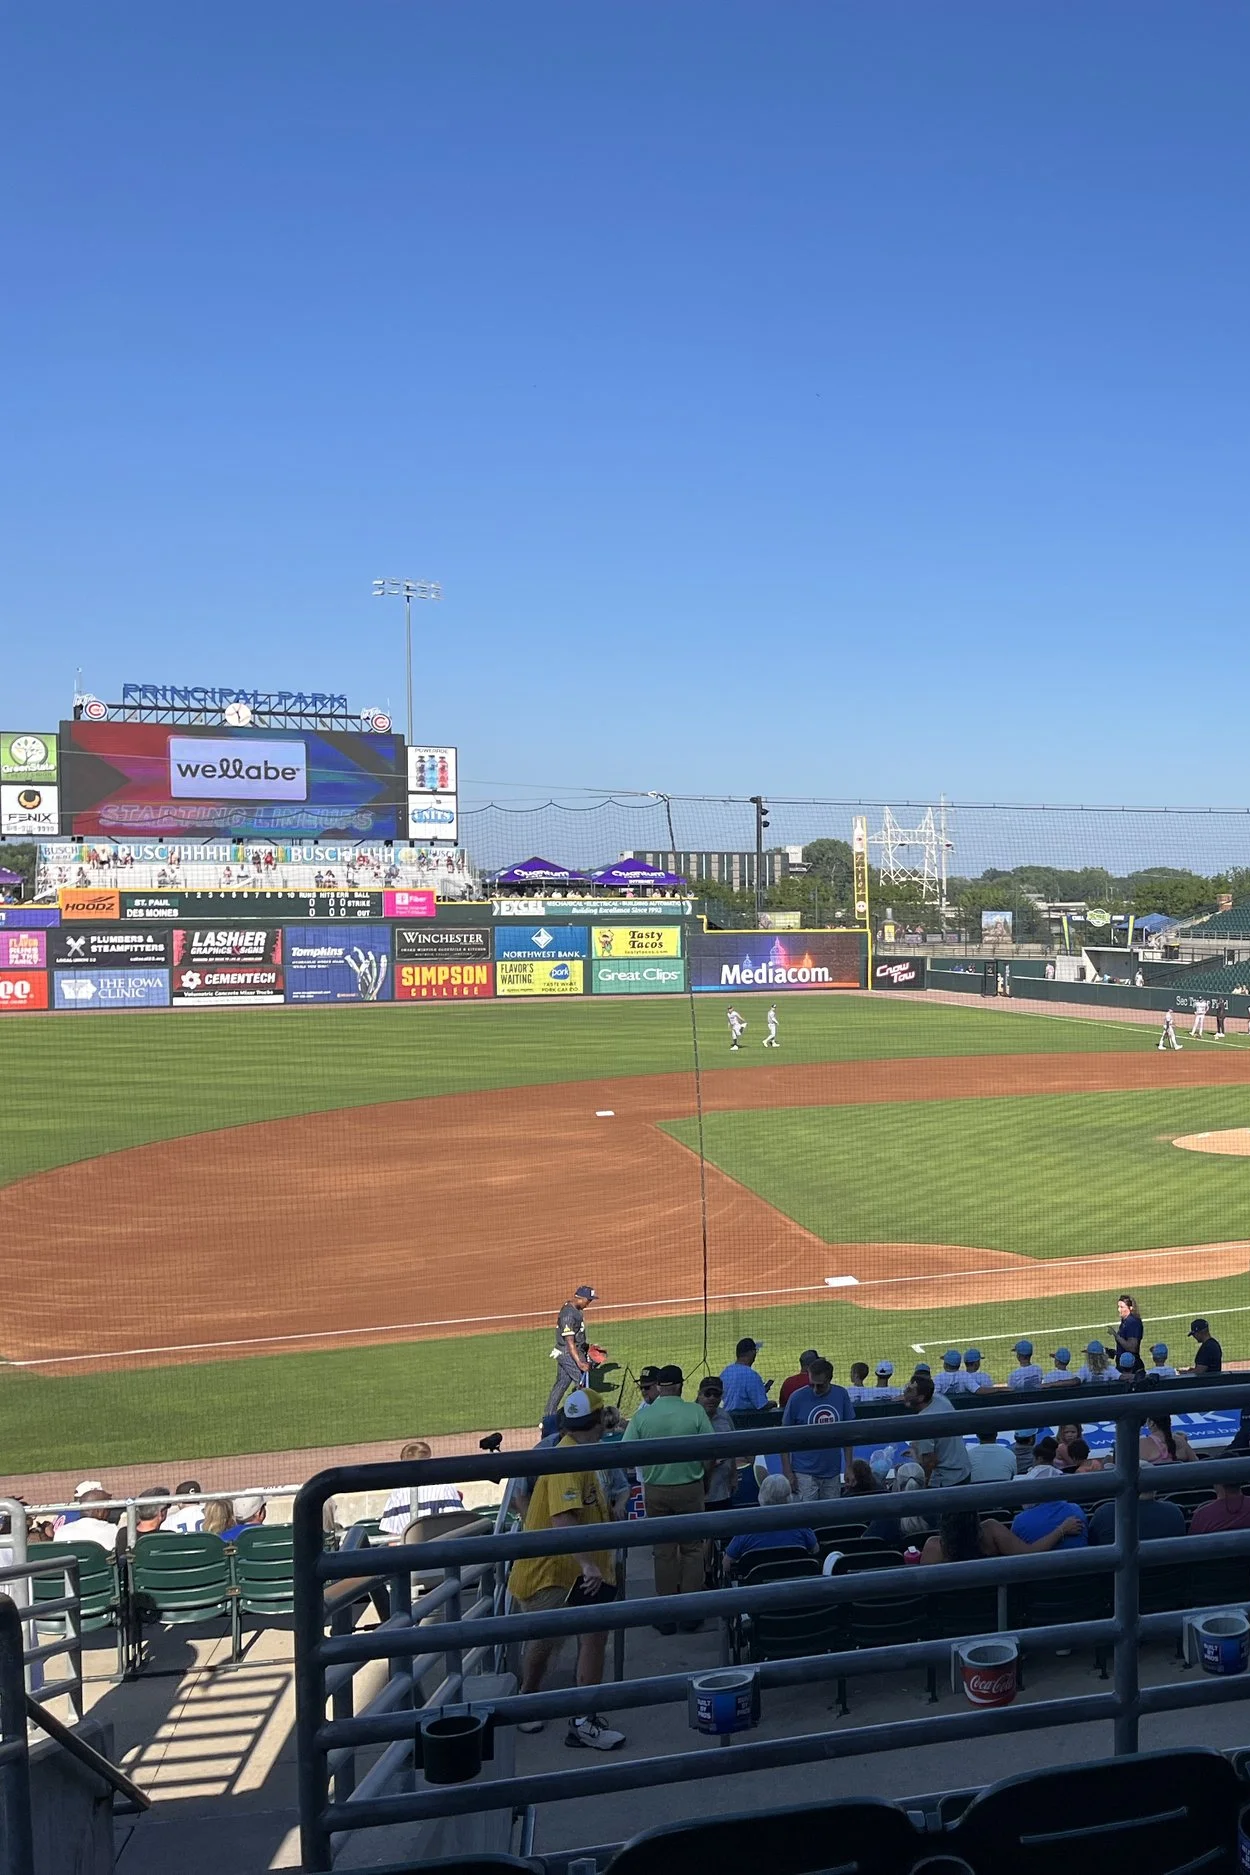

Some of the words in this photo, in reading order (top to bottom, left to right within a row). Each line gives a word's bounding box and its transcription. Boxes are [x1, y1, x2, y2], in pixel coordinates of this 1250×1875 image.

[123, 683, 268, 704] PRINCIPAL
[277, 691, 346, 709] PARK
[176, 758, 297, 780] wellabe
[414, 810, 451, 820] UNITS
[44, 846, 78, 855] BUSCH
[514, 869, 569, 877] Quantum
[612, 870, 665, 878] Quantum
[65, 903, 115, 911] HOODZ
[309, 898, 315, 907] 0
[329, 898, 334, 907] 0
[340, 898, 346, 907] 0
[501, 901, 545, 913] EXCEL
[126, 909, 144, 918] DES
[146, 909, 179, 918] MOINES
[309, 908, 315, 917] 0
[329, 908, 334, 917] 0
[340, 908, 346, 917] 0
[90, 936, 143, 944] PLUMBERS
[146, 936, 154, 944] &
[403, 932, 484, 944] WINCHESTER
[629, 931, 663, 941] Tasty
[9, 938, 38, 948] FLAVOR
[90, 944, 165, 952] STEAMFITTERS
[629, 940, 664, 949] Tacos
[292, 947, 344, 957] Tompkins
[501, 963, 534, 974] FLAVOR'S
[552, 968, 568, 976] pork
[876, 962, 910, 977] Crow
[204, 972, 276, 984] CEMENTECH
[402, 966, 487, 986] SIMPSON
[598, 968, 640, 981] Great
[643, 968, 680, 984] Clips
[890, 970, 916, 984] Tow
[98, 978, 124, 988] THE
[128, 978, 163, 988] IOWA
[98, 988, 146, 998] CLINIC
[410, 986, 478, 996] COLLEGE
[1176, 996, 1188, 1006] Sec
[1204, 1643, 1218, 1651] BUILT
